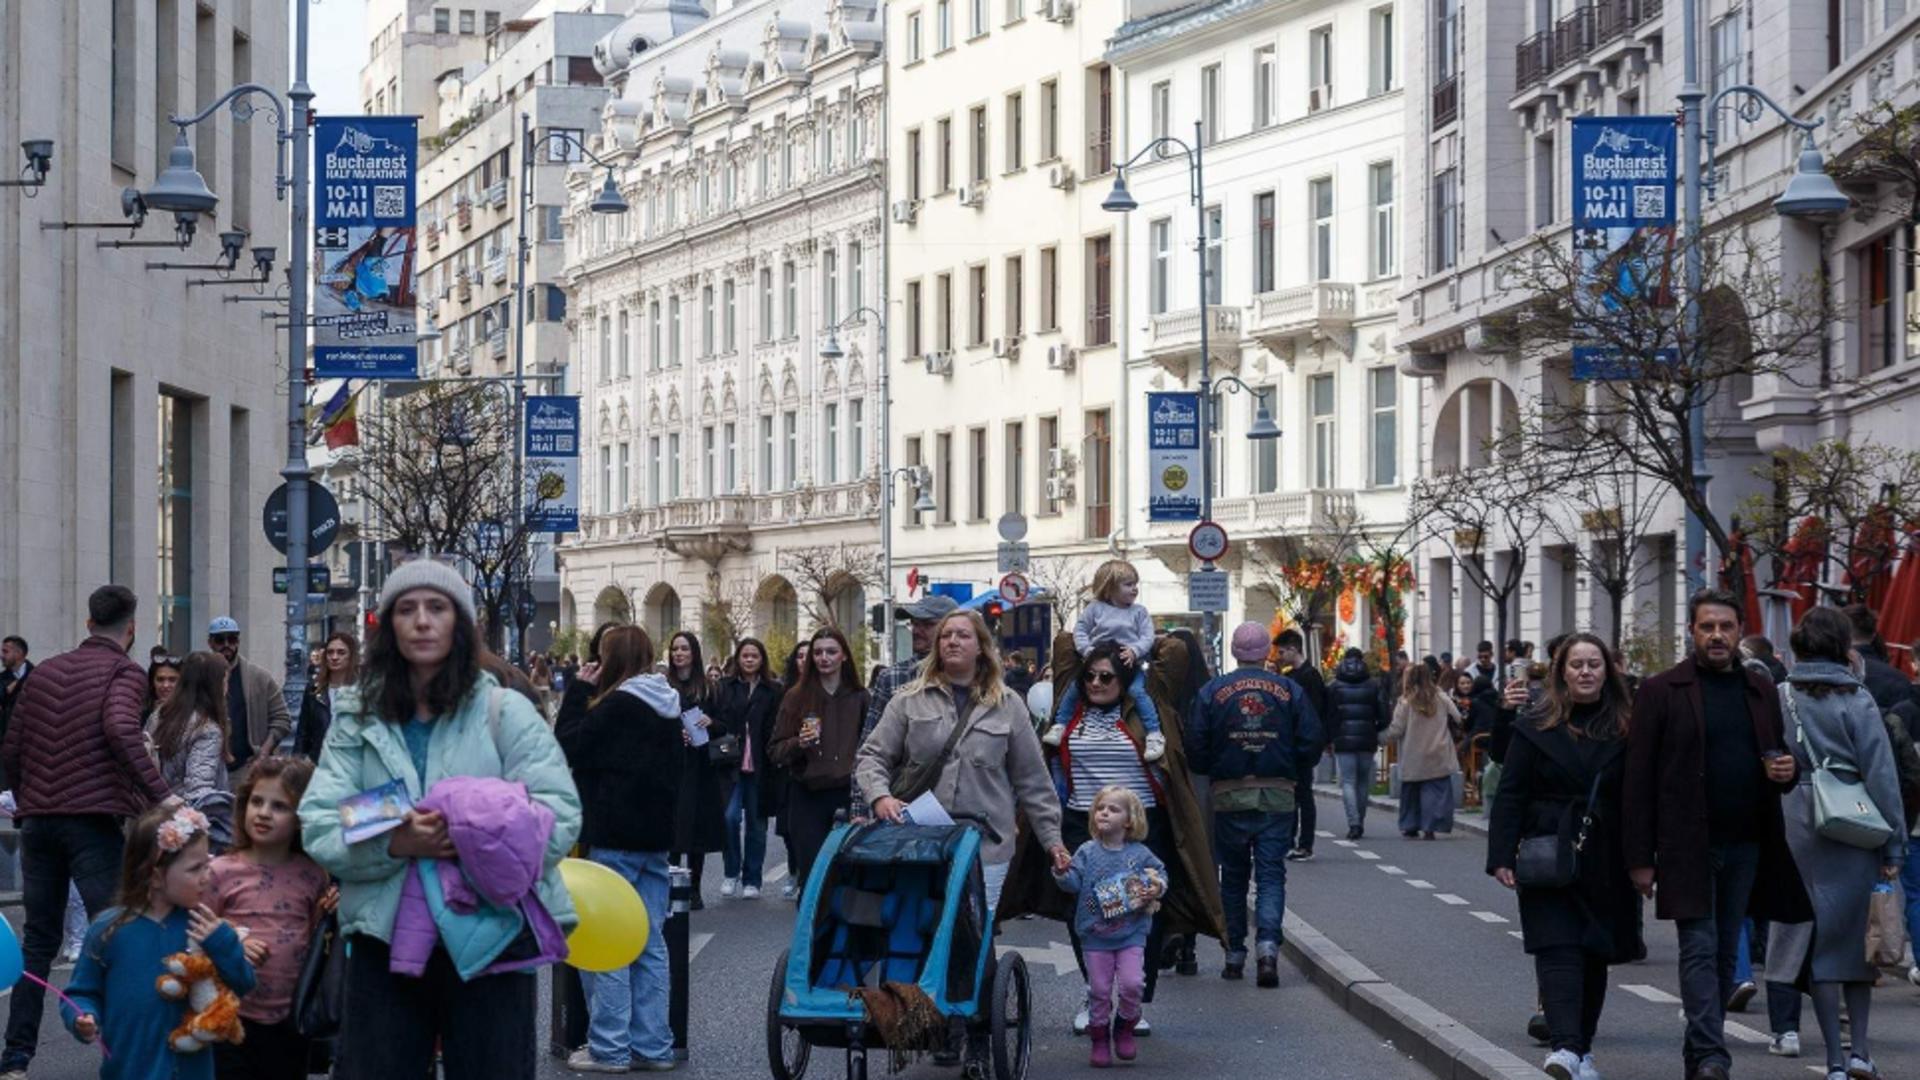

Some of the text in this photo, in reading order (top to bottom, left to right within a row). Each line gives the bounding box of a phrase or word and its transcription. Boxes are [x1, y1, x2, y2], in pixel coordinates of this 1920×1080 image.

[326, 153, 407, 169] Bucharest
[1583, 153, 1667, 169] Bucharest
[326, 169, 350, 179] HALF
[326, 185, 367, 200] 10-11
[1584, 185, 1626, 200] 10-11
[326, 201, 367, 218] MAI
[1584, 202, 1627, 218] MAI
[530, 442, 553, 452] MAI
